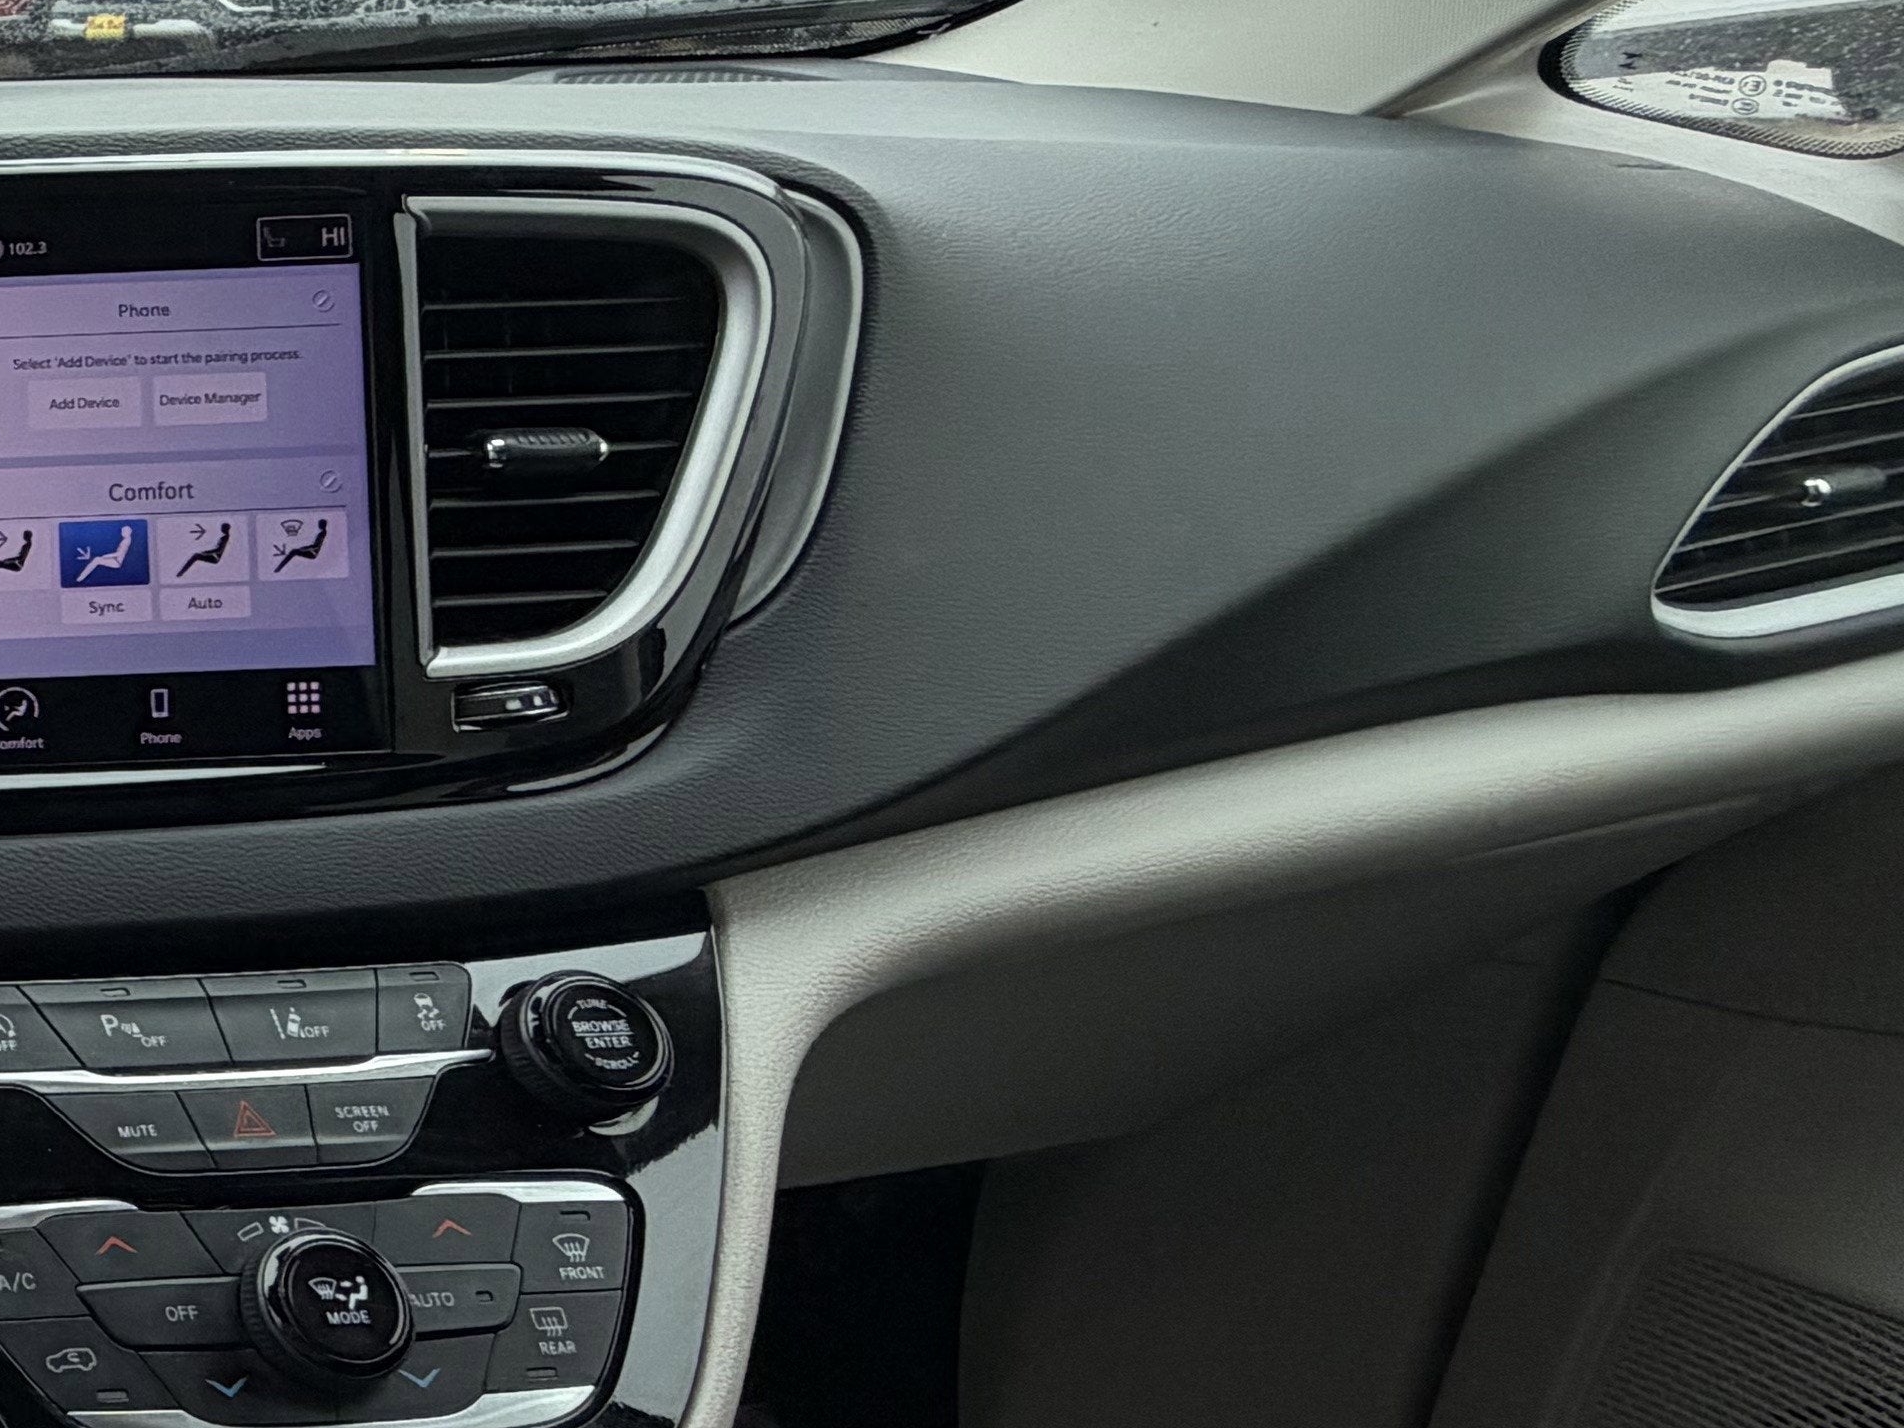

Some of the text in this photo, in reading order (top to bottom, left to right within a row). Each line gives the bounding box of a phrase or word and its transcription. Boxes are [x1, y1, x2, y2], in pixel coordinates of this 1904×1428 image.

[321, 227, 346, 247] HI
[8, 242, 48, 256] 102.3
[118, 302, 171, 318] Phone
[13, 357, 51, 371] Select
[135, 354, 147, 365] to
[150, 352, 179, 365] start
[181, 351, 203, 365] the
[205, 350, 247, 366] pairing
[49, 396, 120, 410] Add Device
[160, 390, 261, 407] Device Manager
[108, 482, 194, 502] Comfort
[88, 600, 125, 616] Sync
[187, 596, 223, 610] Auto
[140, 730, 182, 745] Phone
[288, 726, 322, 741] Apps
[577, 998, 608, 1011] TUNE
[100, 1014, 118, 1038] P
[305, 1025, 329, 1038] OFF
[420, 1018, 445, 1032] OFF
[572, 1019, 631, 1034] BROWSE
[141, 1035, 167, 1048] OFF
[585, 1035, 632, 1049] ENTER
[595, 1056, 639, 1071] SCROLL
[335, 1105, 390, 1120] SCREEN
[118, 1123, 157, 1139] MUTE
[353, 1119, 379, 1133] OFF
[559, 1266, 605, 1281] FRONT
[410, 1291, 455, 1308] AUTO
[165, 1304, 198, 1323] OFF
[327, 1309, 371, 1326] MODE
[538, 1341, 577, 1356] REAR
